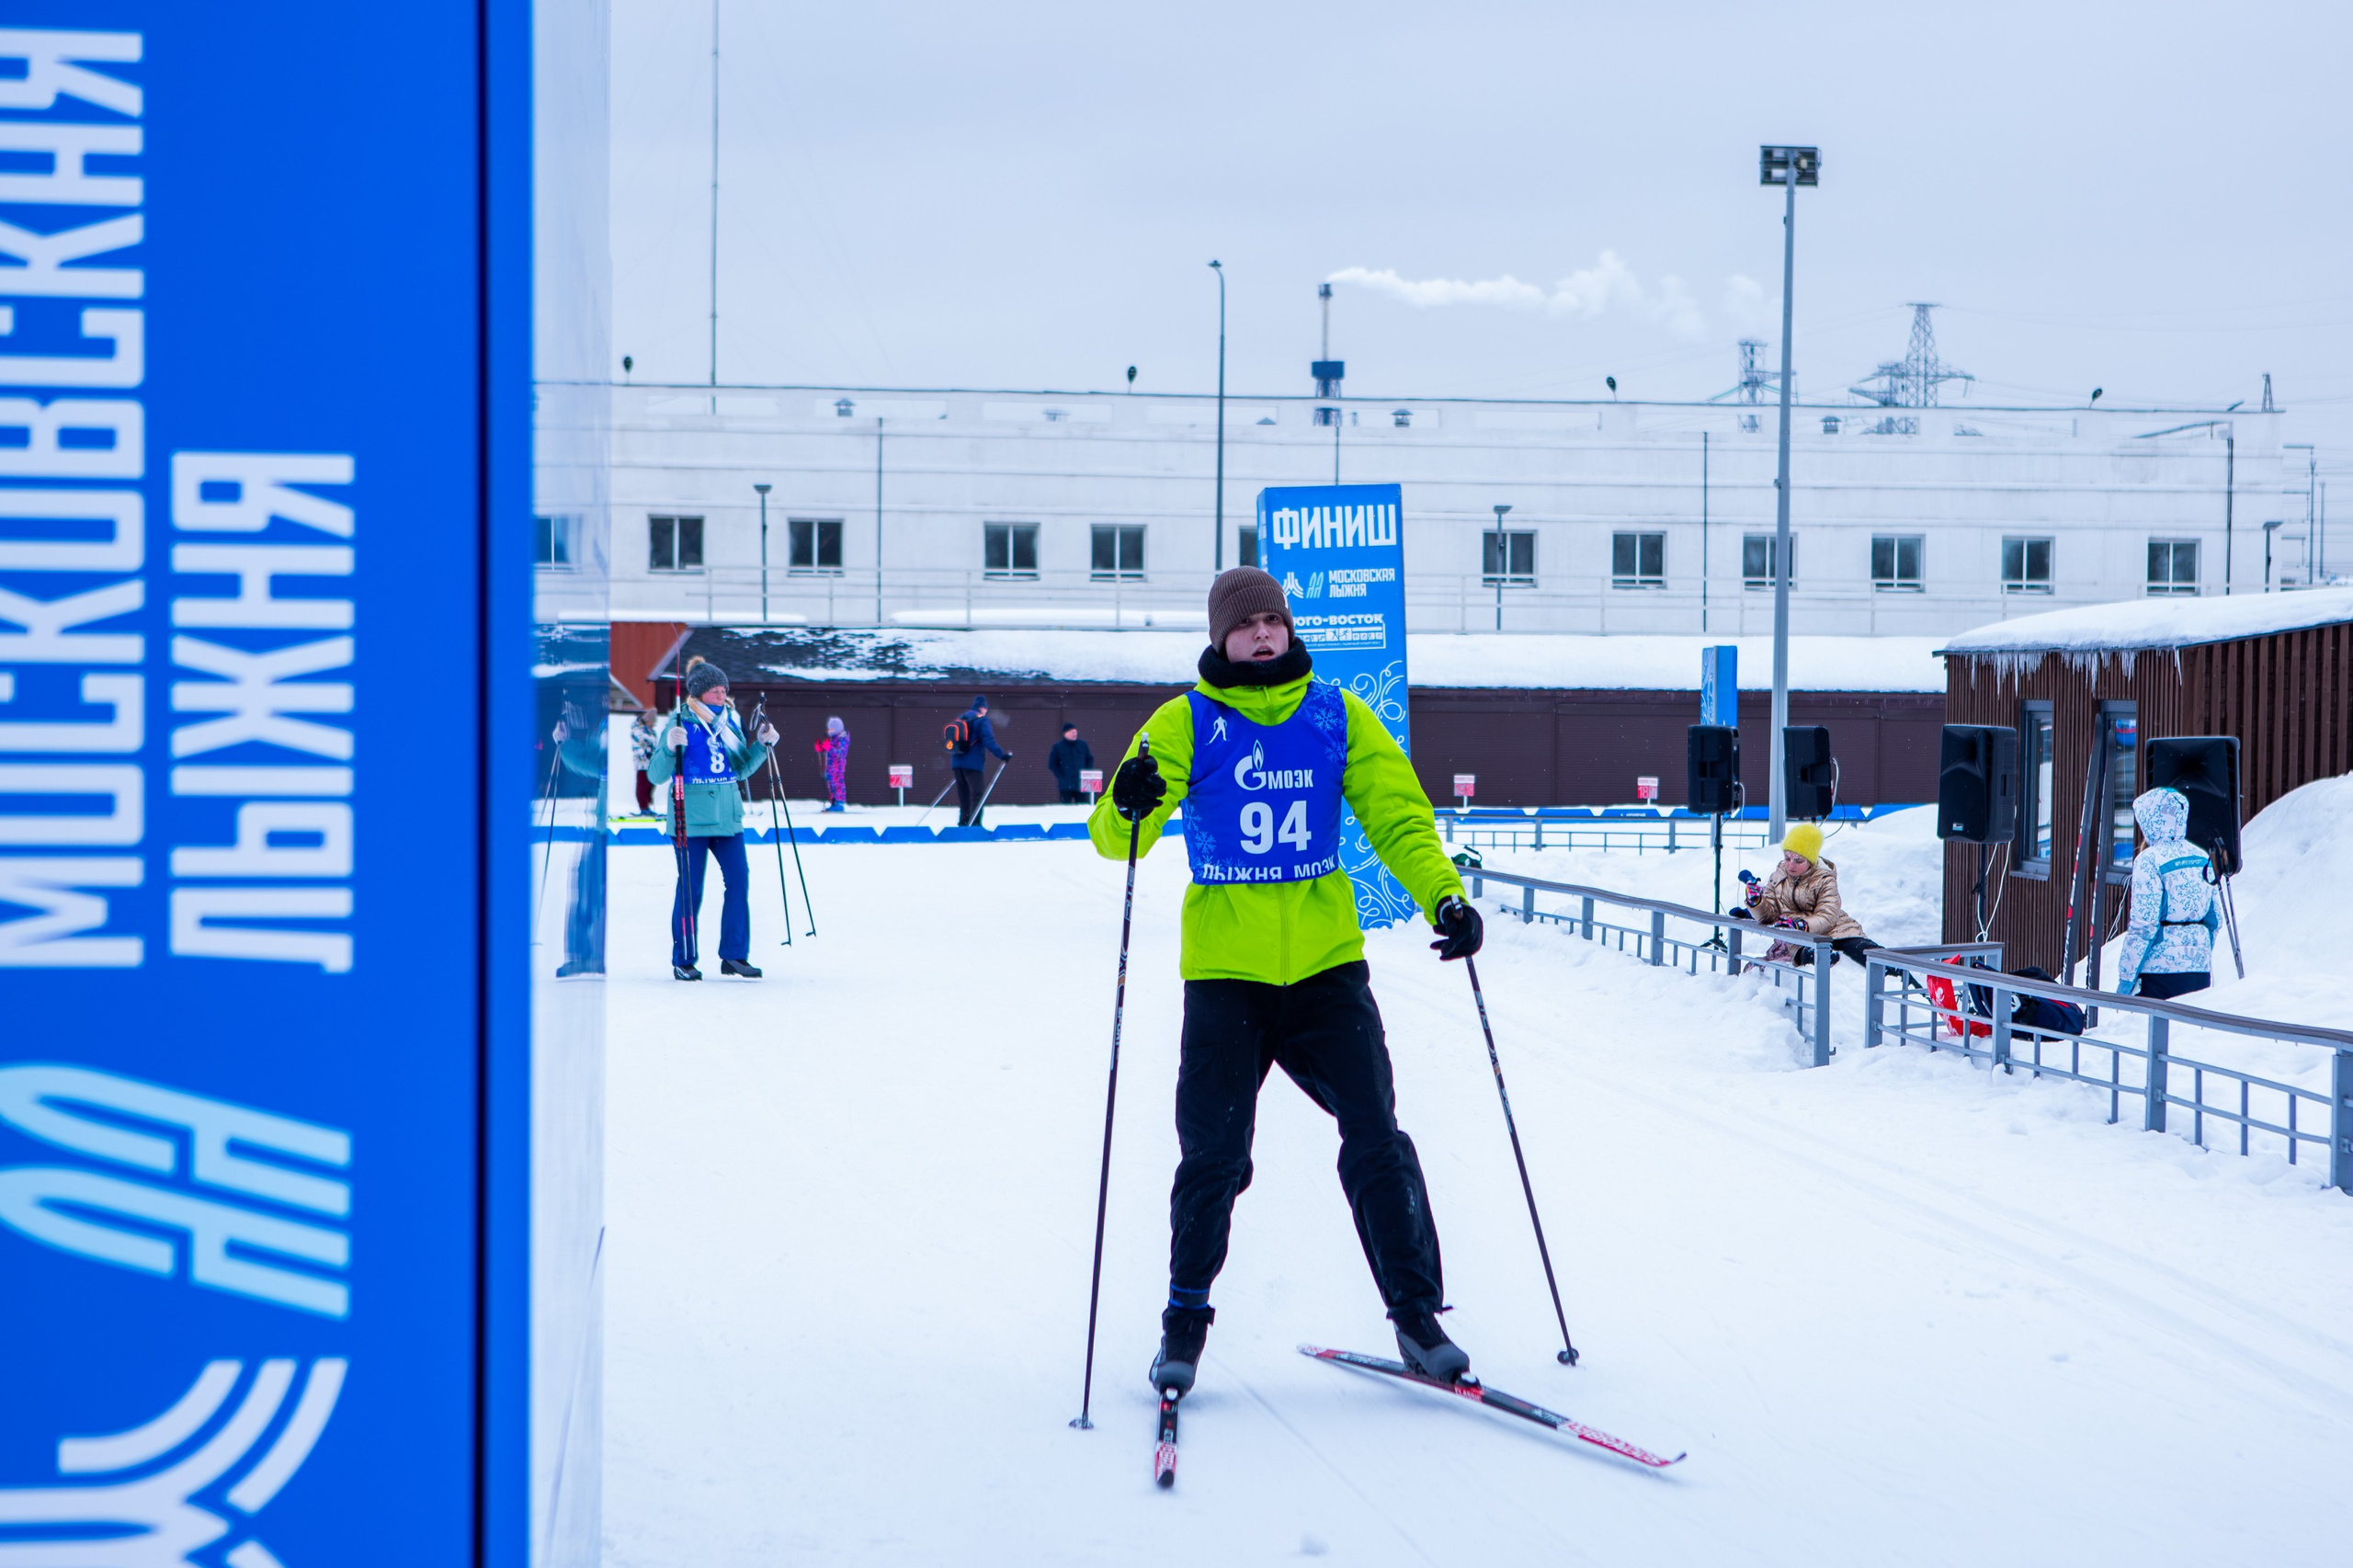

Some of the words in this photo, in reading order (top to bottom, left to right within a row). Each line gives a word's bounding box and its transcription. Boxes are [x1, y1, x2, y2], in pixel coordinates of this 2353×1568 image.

[1272, 504, 1398, 551] ФИНИШ
[1328, 567, 1395, 584] МОСКОВСКАЯ
[1328, 583, 1367, 598] ЛЫЖНЯ
[169, 450, 356, 974] ЛЫЖНЯ
[1239, 800, 1312, 855] 94
